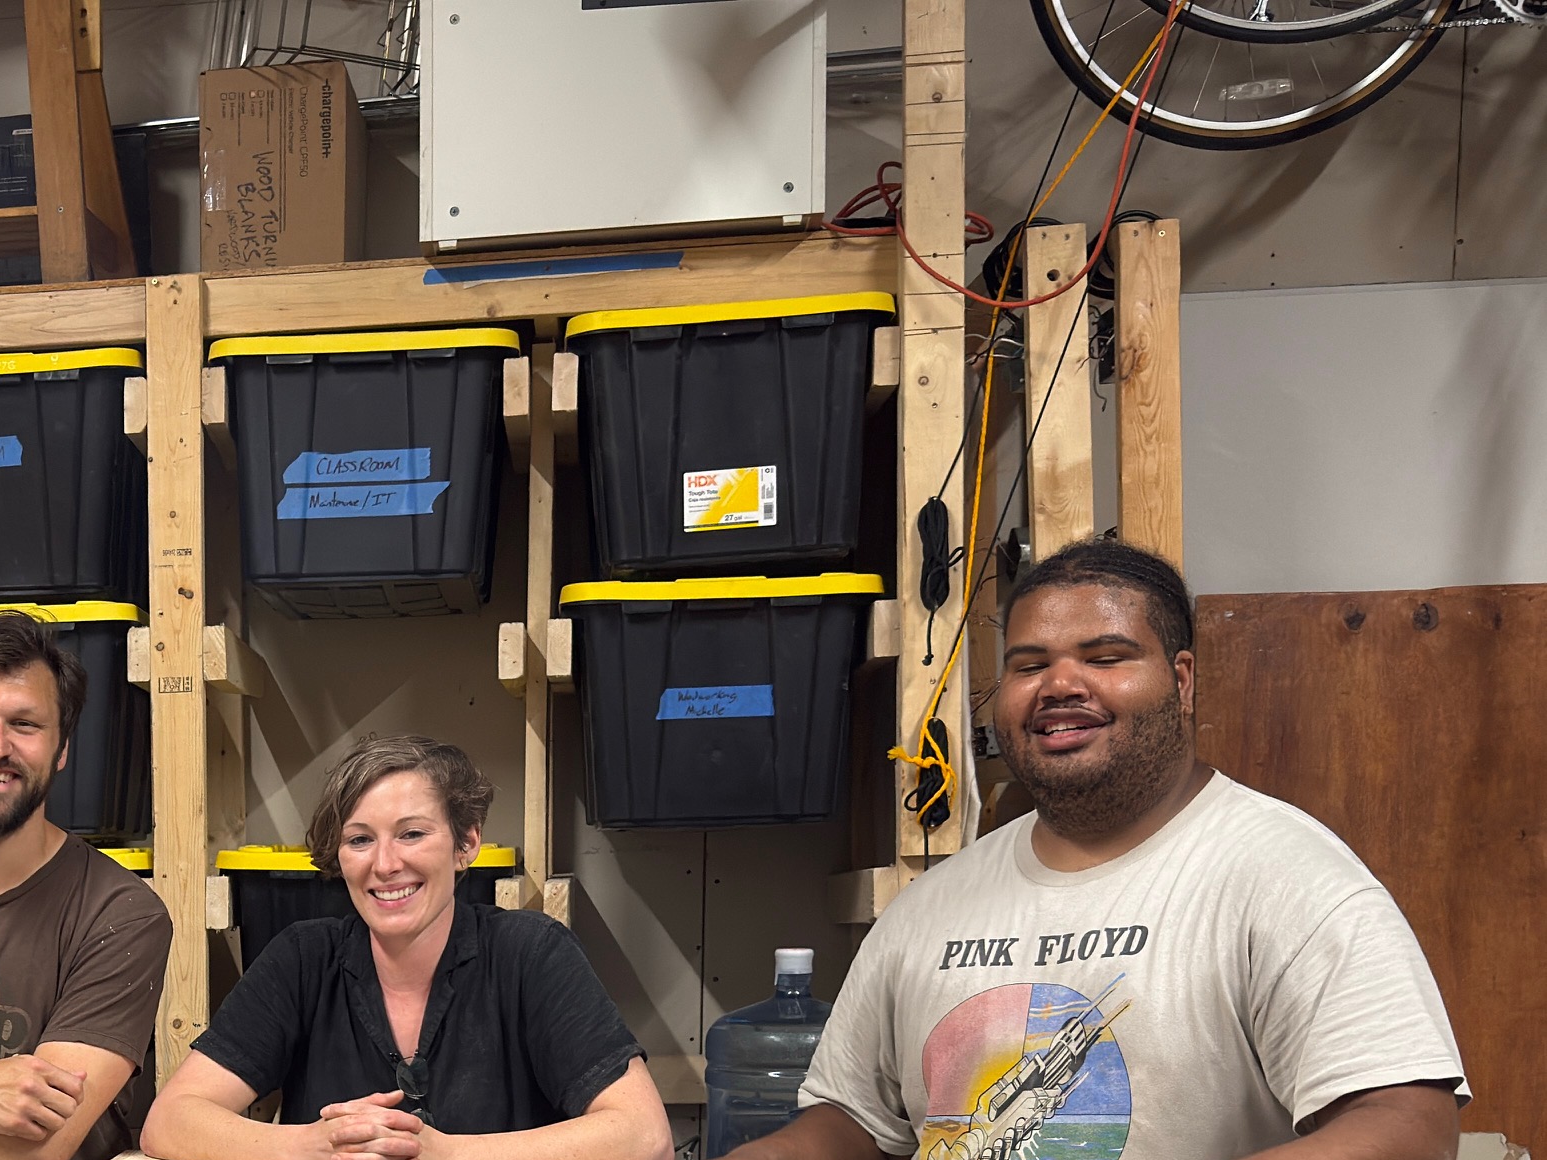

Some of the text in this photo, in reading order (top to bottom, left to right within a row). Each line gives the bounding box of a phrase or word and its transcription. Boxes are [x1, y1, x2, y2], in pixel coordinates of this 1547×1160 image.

[252, 150, 274, 201] WOOD
[237, 183, 261, 262] BLANKS
[316, 457, 400, 475] CLASSROOM
[688, 475, 717, 488] HDX
[684, 703, 725, 716] Michelle
[939, 925, 1149, 970] PINK FLOYD
